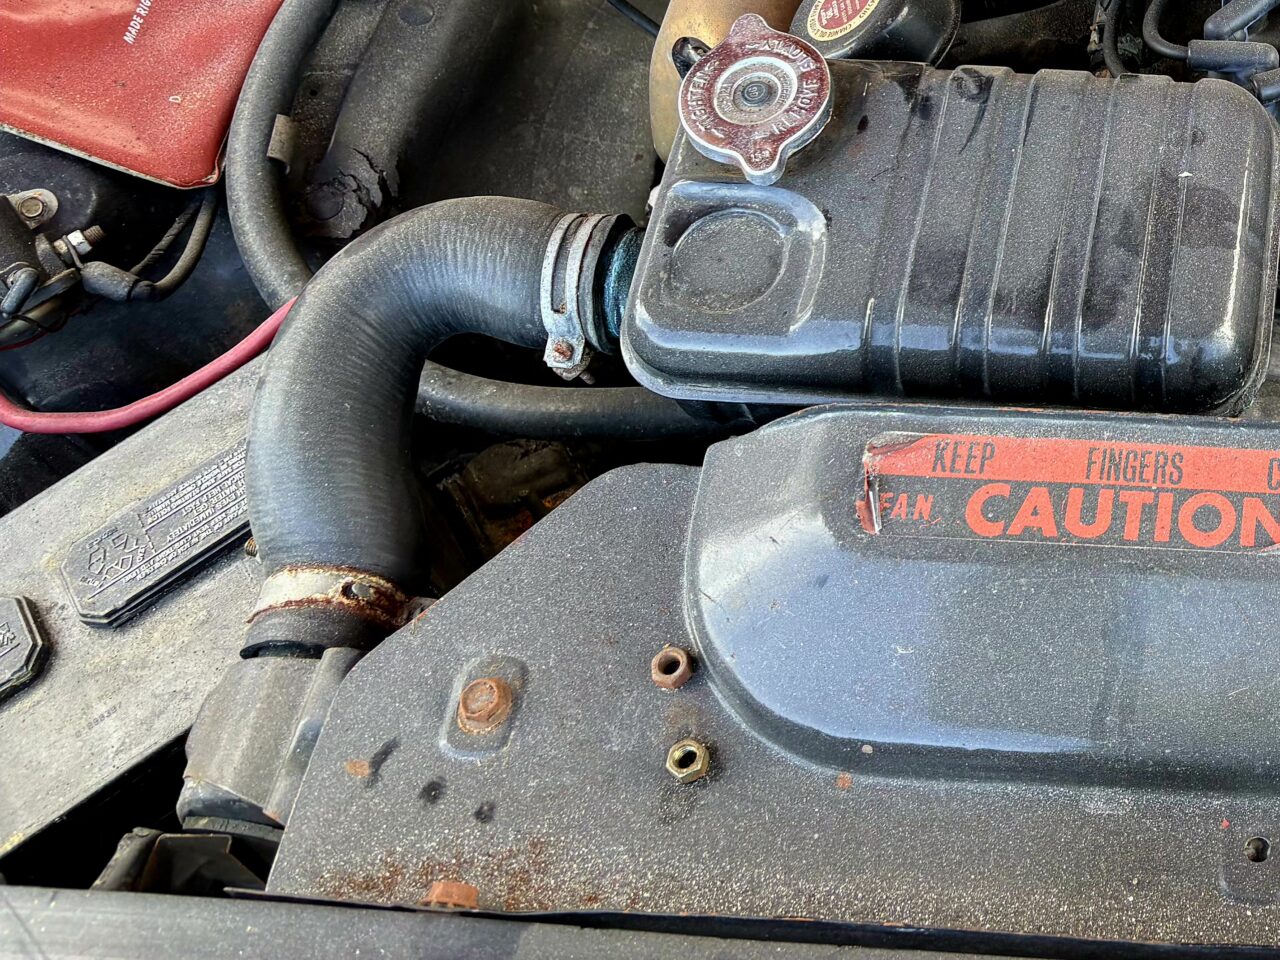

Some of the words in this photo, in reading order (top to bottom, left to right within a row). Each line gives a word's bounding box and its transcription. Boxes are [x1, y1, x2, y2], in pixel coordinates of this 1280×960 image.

[123, 14, 144, 44] MADE
[932, 439, 996, 475] KEEP
[1085, 447, 1185, 486] FINGERS
[881, 490, 933, 522] FAN
